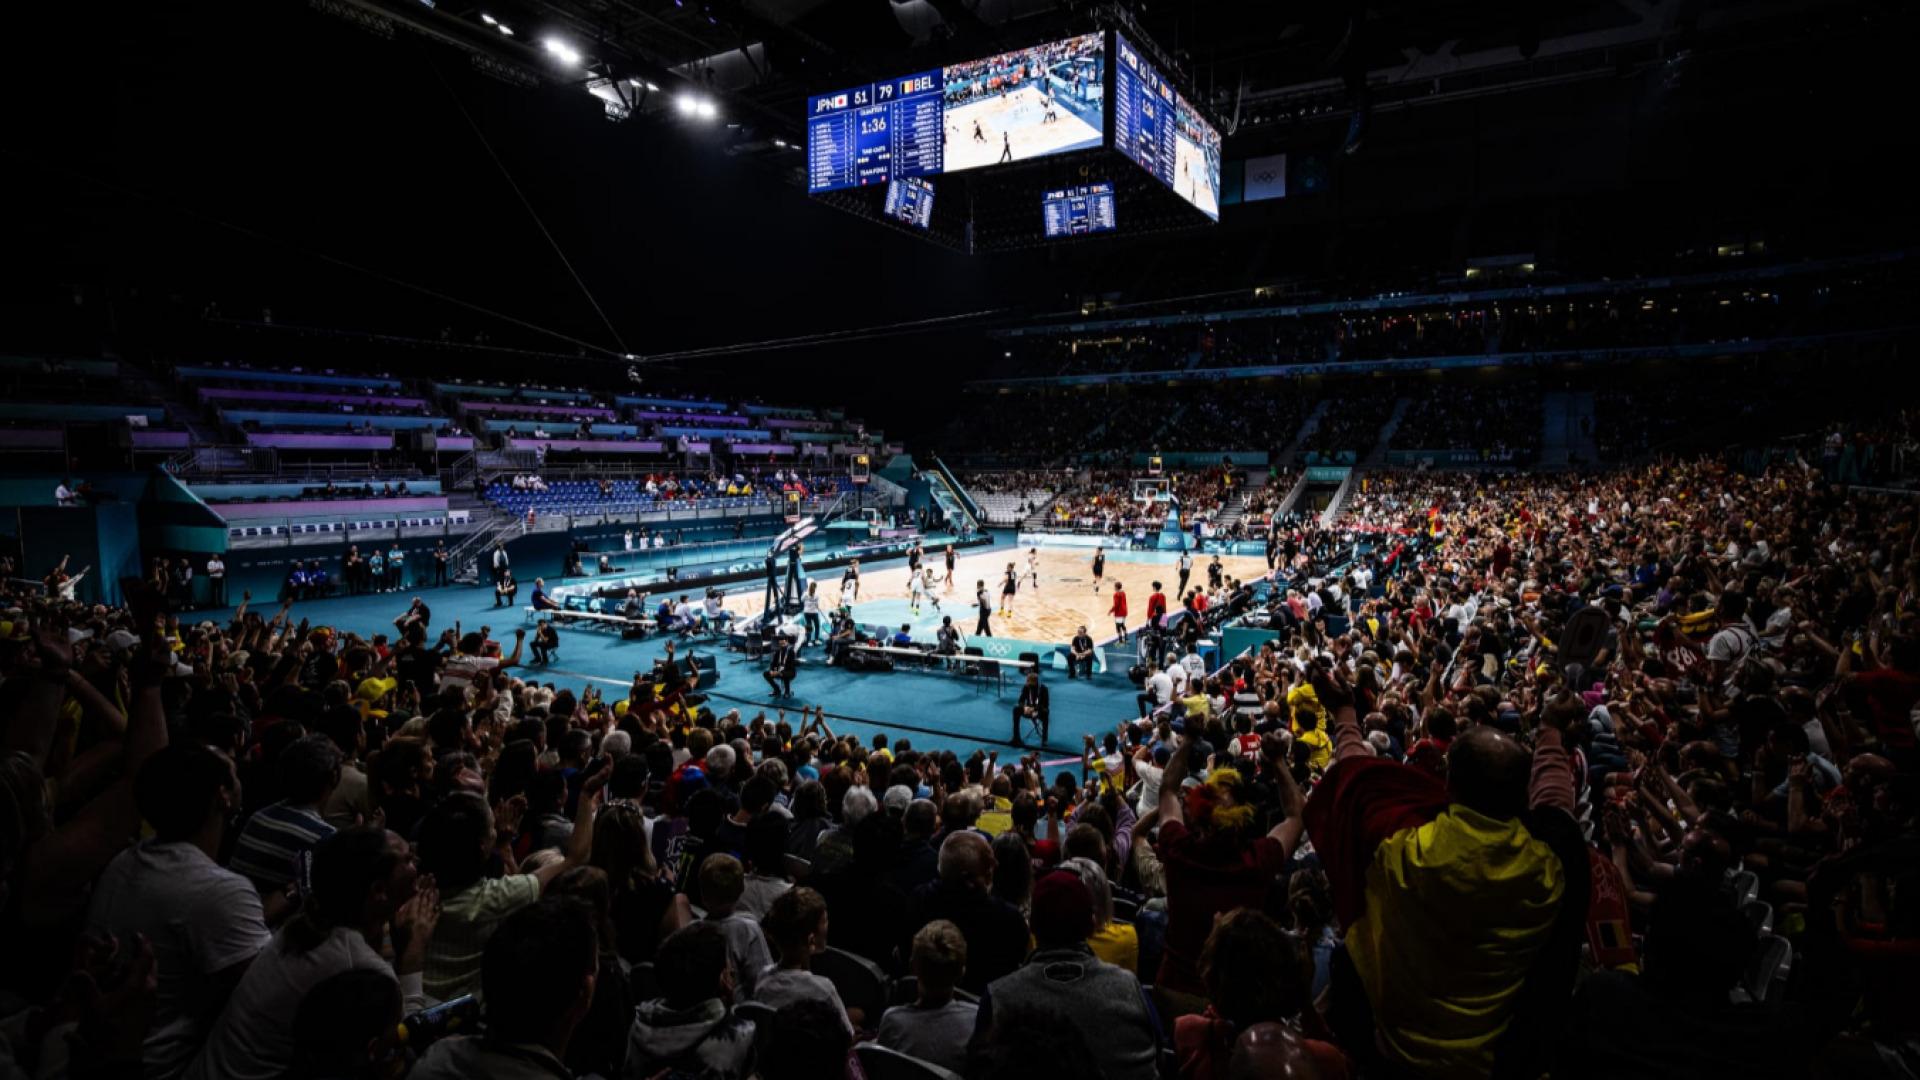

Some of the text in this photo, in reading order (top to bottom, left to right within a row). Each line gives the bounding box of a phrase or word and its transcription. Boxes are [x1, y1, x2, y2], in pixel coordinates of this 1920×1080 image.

[816, 75, 935, 112] JPN 51 79 BEL
[861, 117, 886, 134] 1:36
